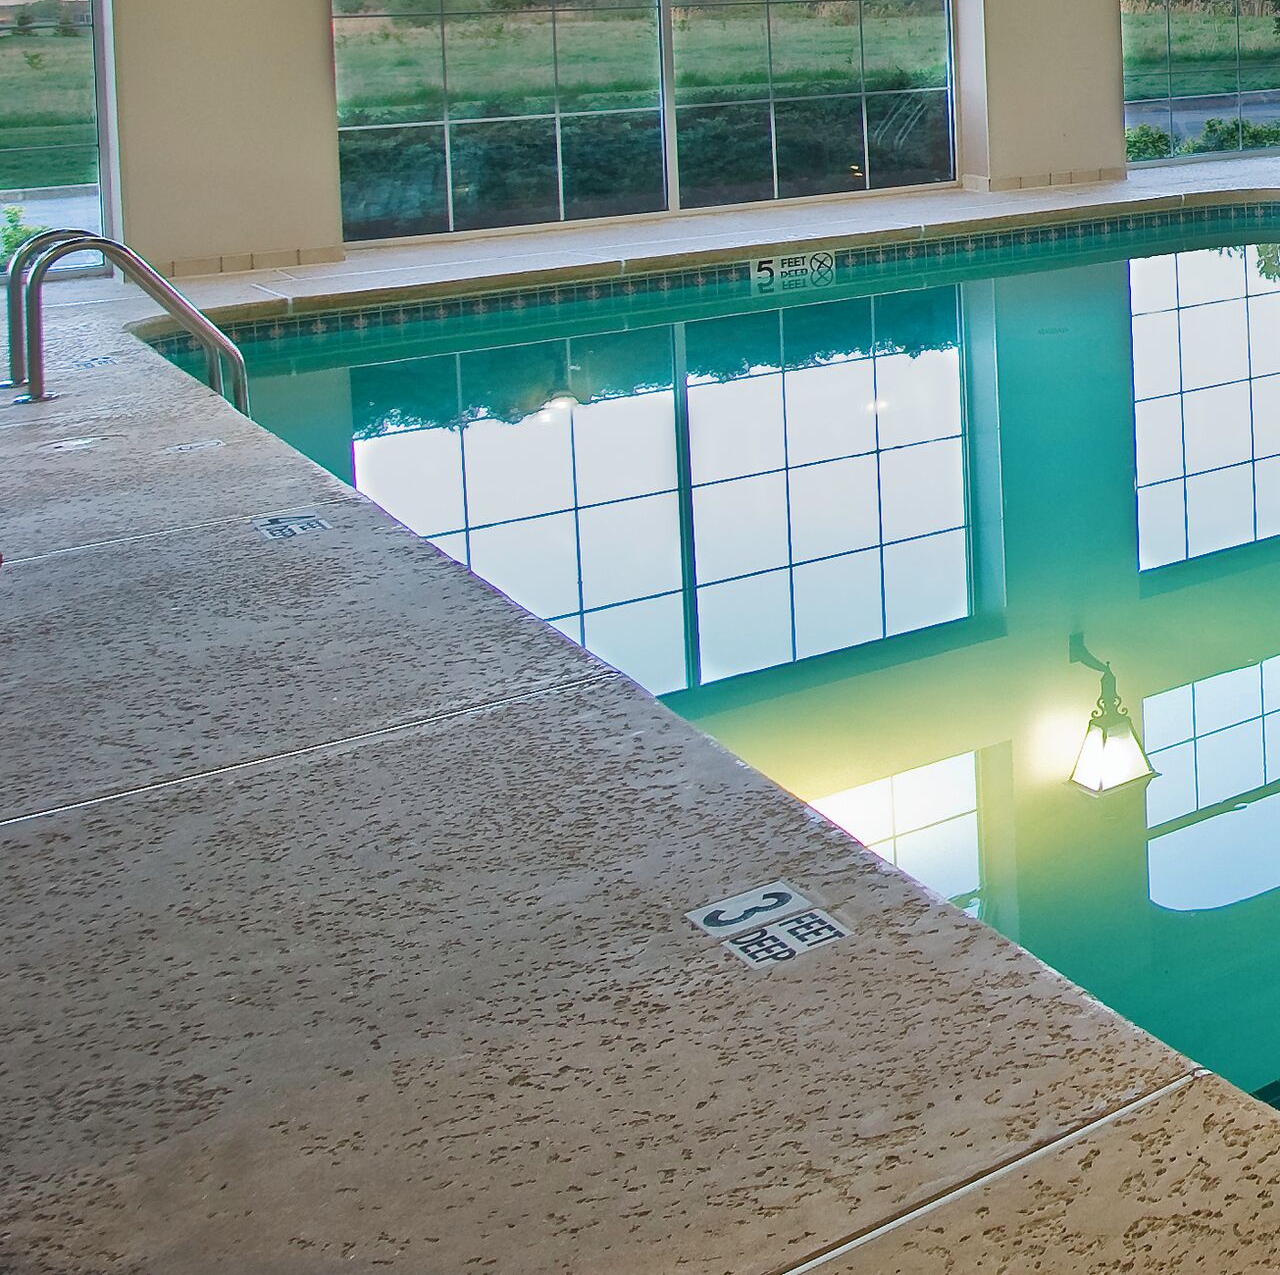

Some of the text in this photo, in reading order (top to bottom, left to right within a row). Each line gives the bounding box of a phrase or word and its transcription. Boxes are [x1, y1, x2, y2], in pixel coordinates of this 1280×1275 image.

[757, 256, 806, 282] 5 FEET
[703, 891, 846, 947] 3 FEET
[729, 928, 797, 963] DEEP
